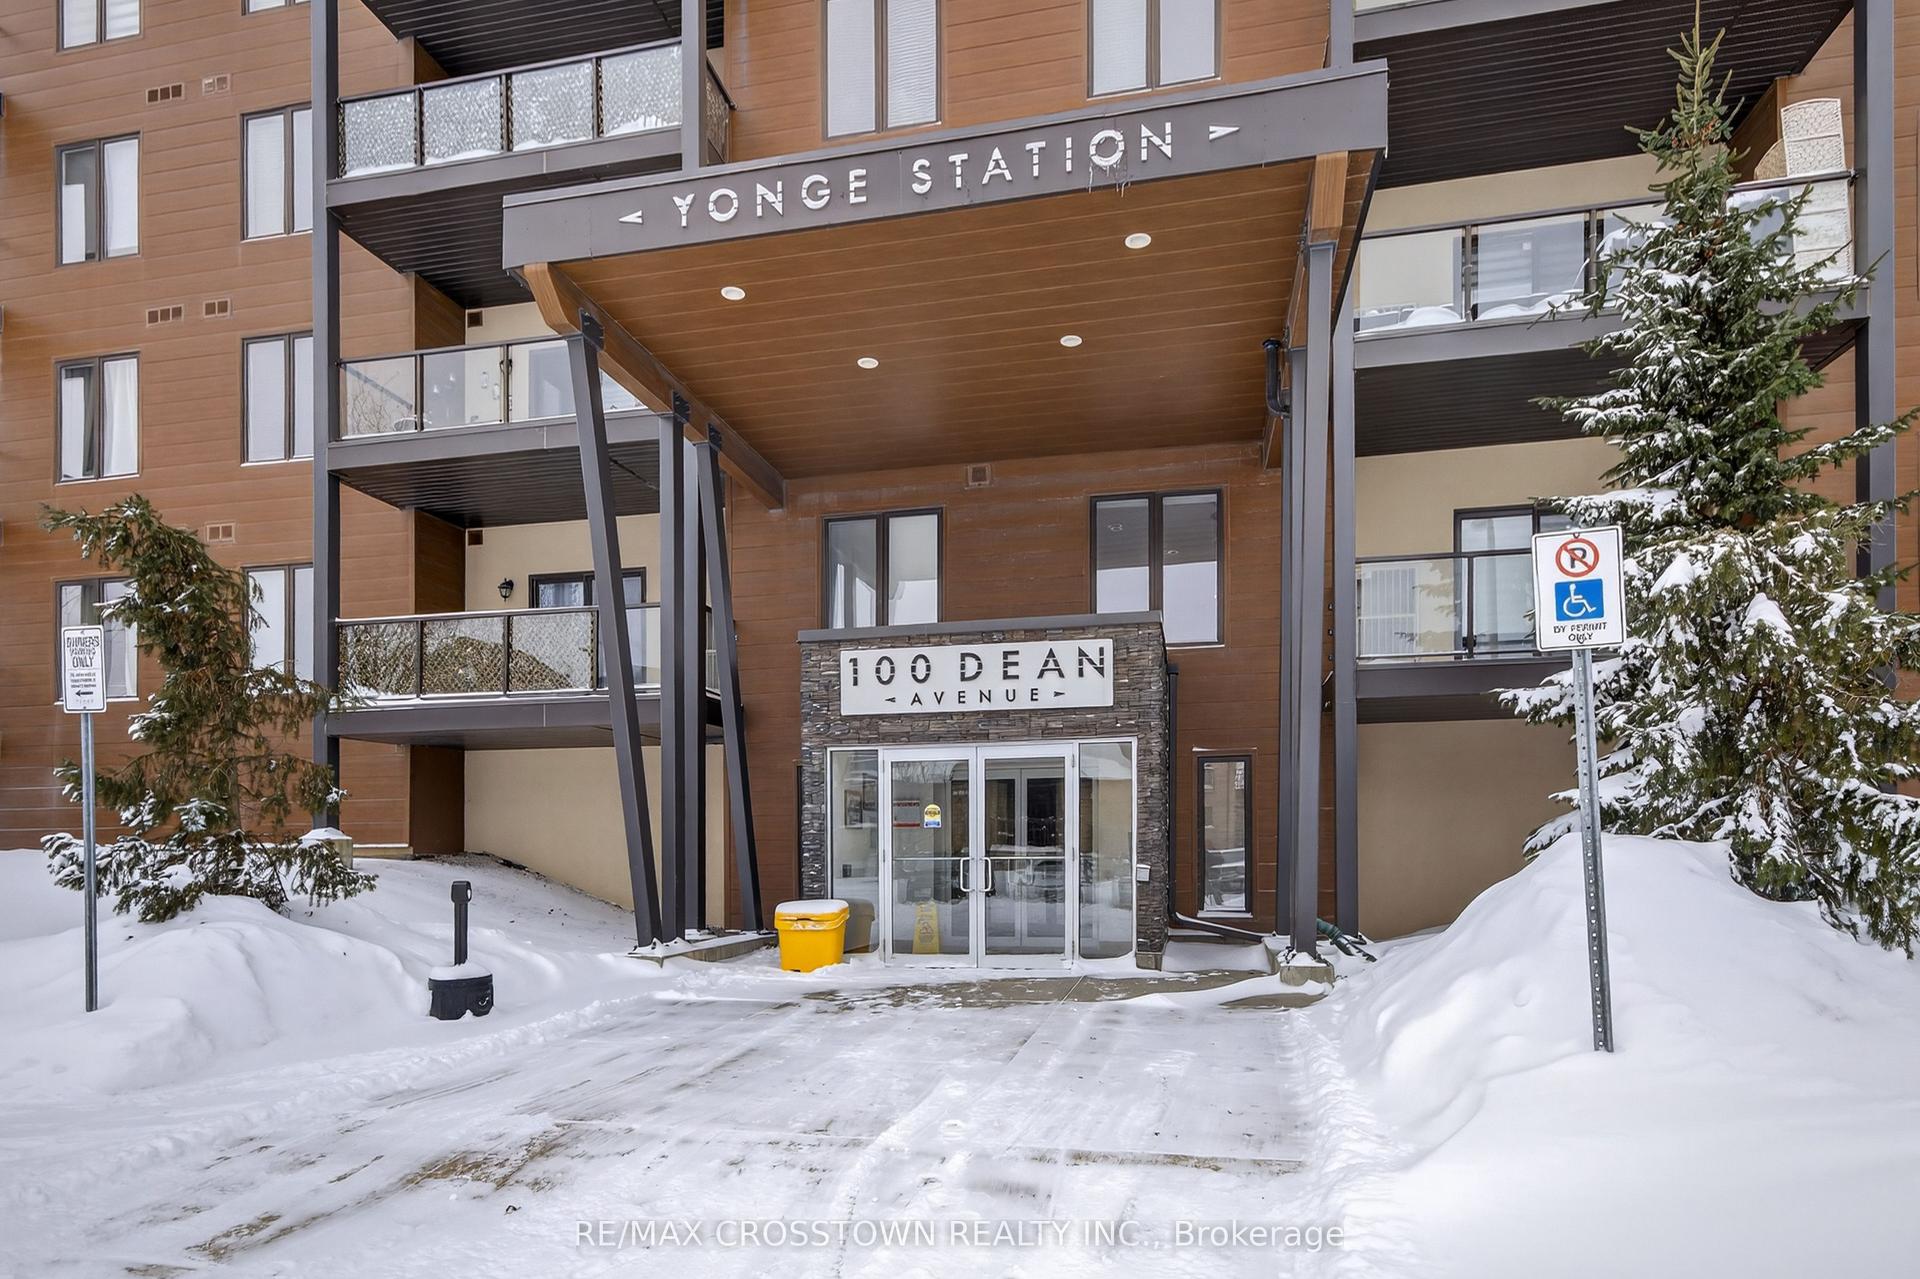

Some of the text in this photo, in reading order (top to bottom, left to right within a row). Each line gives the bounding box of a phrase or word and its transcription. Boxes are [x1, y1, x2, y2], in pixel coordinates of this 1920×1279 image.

[672, 121, 1172, 228] YONGE STATION
[1553, 624, 1567, 633] BY
[72, 656, 94, 668] ONLY
[848, 645, 1105, 687] 100 DEAN
[910, 688, 1039, 706] AVENUE
